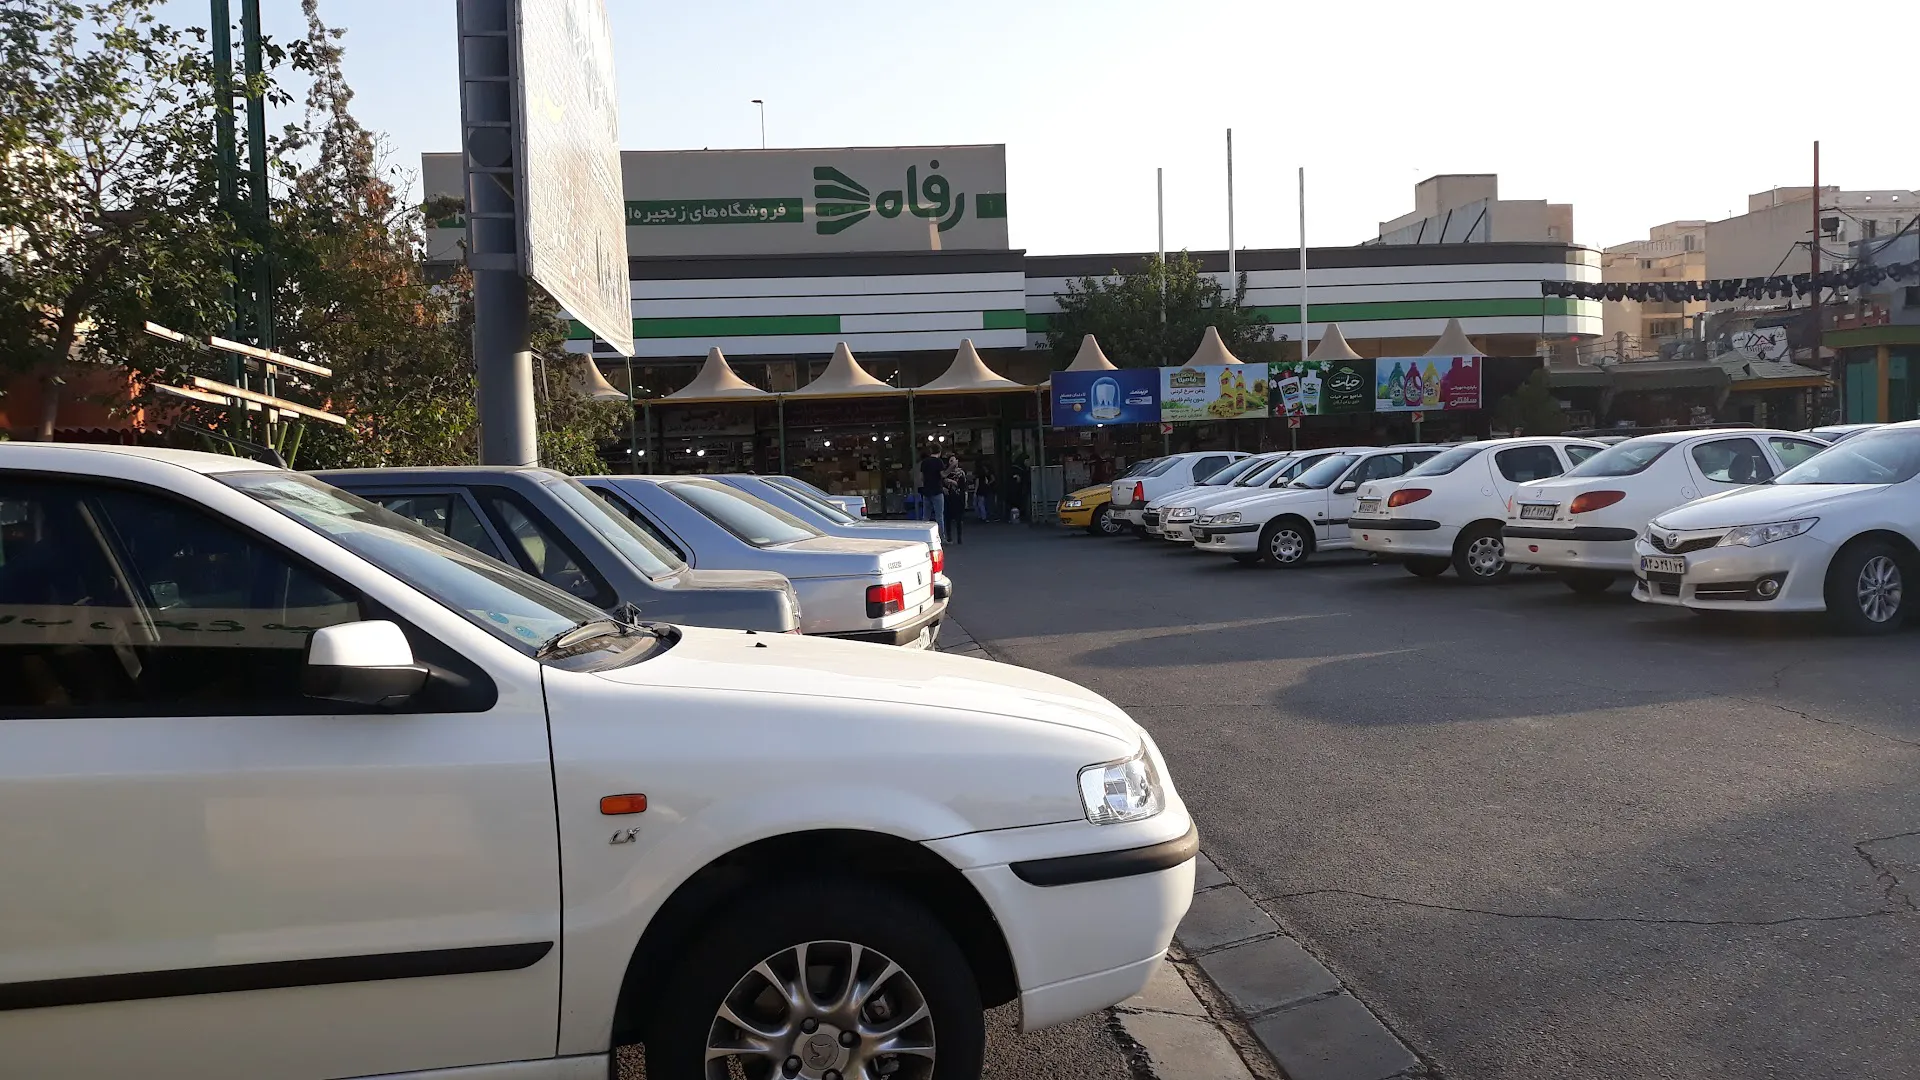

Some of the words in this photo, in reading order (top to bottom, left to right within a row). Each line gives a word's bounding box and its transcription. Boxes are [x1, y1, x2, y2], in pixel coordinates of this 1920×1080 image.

[876, 159, 965, 233] رفاه
[1330, 374, 1360, 390] حیات
[609, 827, 641, 844] LX
